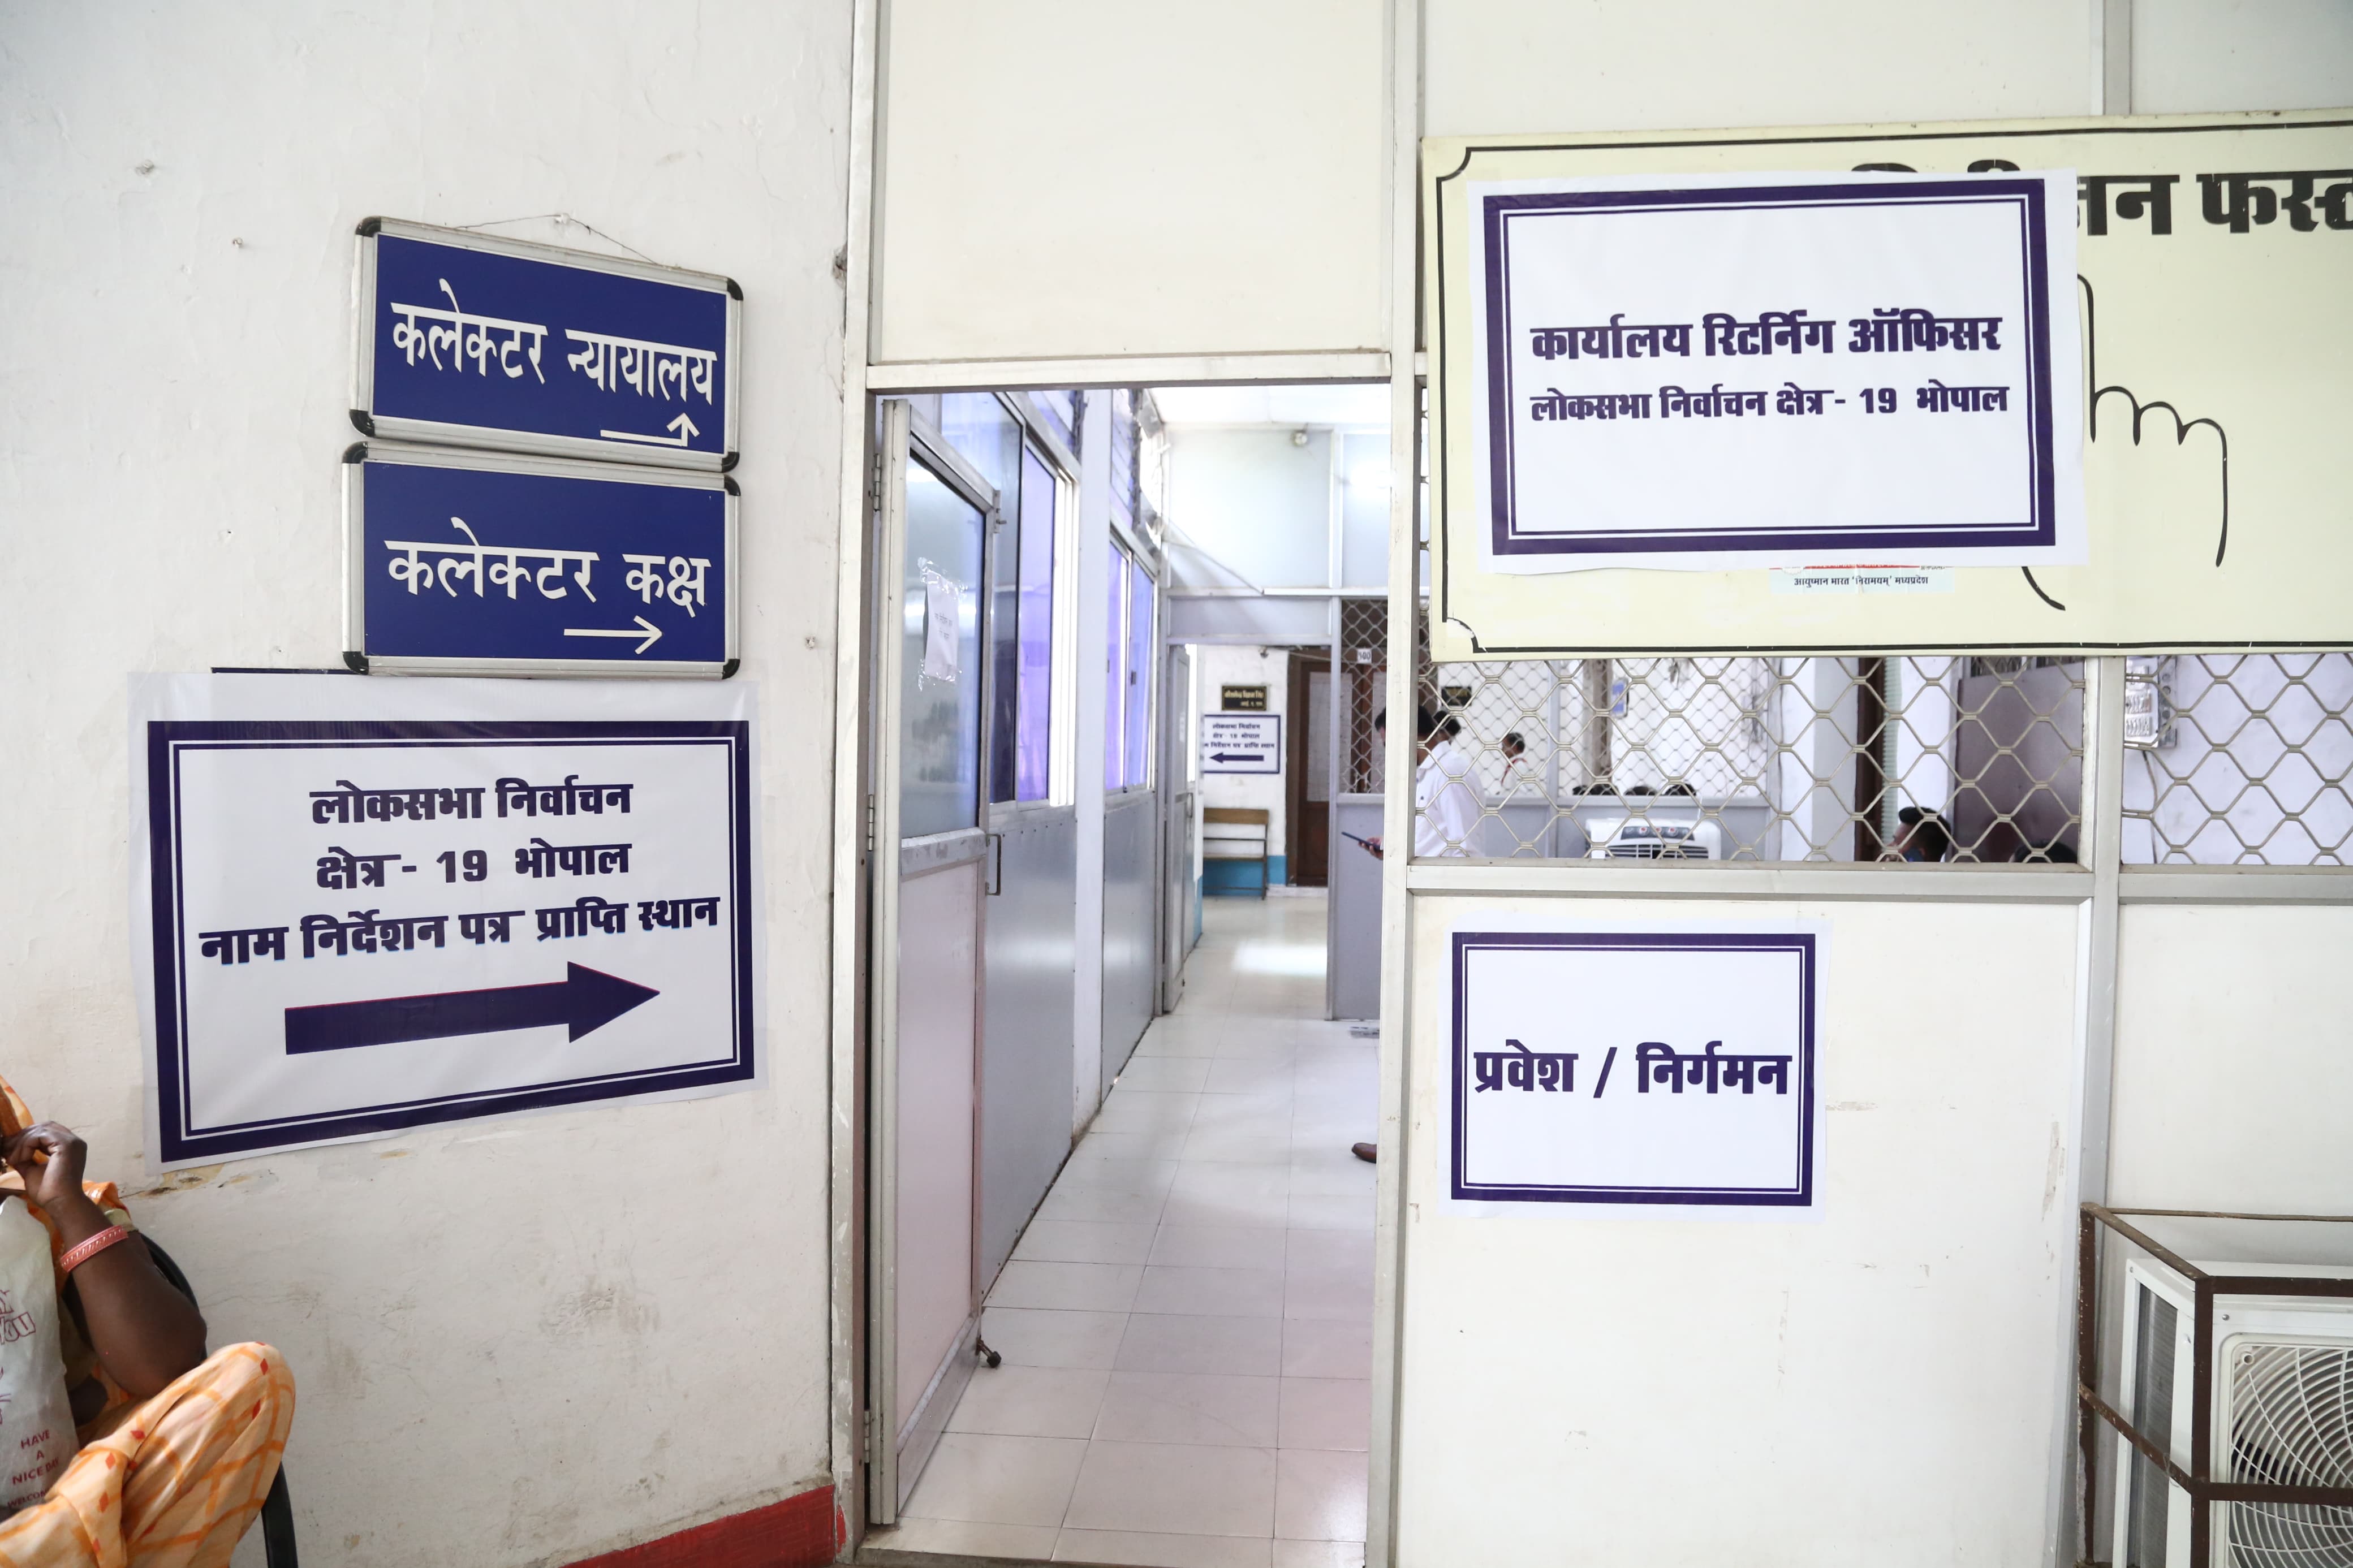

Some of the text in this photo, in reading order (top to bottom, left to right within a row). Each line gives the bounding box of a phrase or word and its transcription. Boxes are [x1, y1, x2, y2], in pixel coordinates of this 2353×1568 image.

[391, 279, 718, 405] कलेक्टर न्यायालय
[1530, 314, 1693, 360] कार्यालय
[1848, 308, 2003, 353] ऑफिसर
[1530, 387, 1653, 421] लोकसभा
[1659, 383, 1769, 418] निर्वाचन
[1859, 387, 1897, 414] 19
[1916, 379, 2010, 413] भोपाल
[384, 517, 712, 617] कलेक्टर कक्ष
[1794, 577, 1828, 588] आयुष्मान
[1895, 574, 1929, 585] मध्यप्रदेश
[309, 774, 634, 824] लोकसभा निर्वाचन
[436, 849, 488, 883] 19
[515, 837, 632, 878] भोपाल
[199, 896, 721, 965] नाम निर्देशन पत्र प्राप्ति स्थान
[1473, 1039, 1793, 1099] प्रवेश / निर्गमन
[21, 1429, 50, 1449] HAVE
[37, 1450, 45, 1461] A
[12, 1466, 43, 1485] NICE
